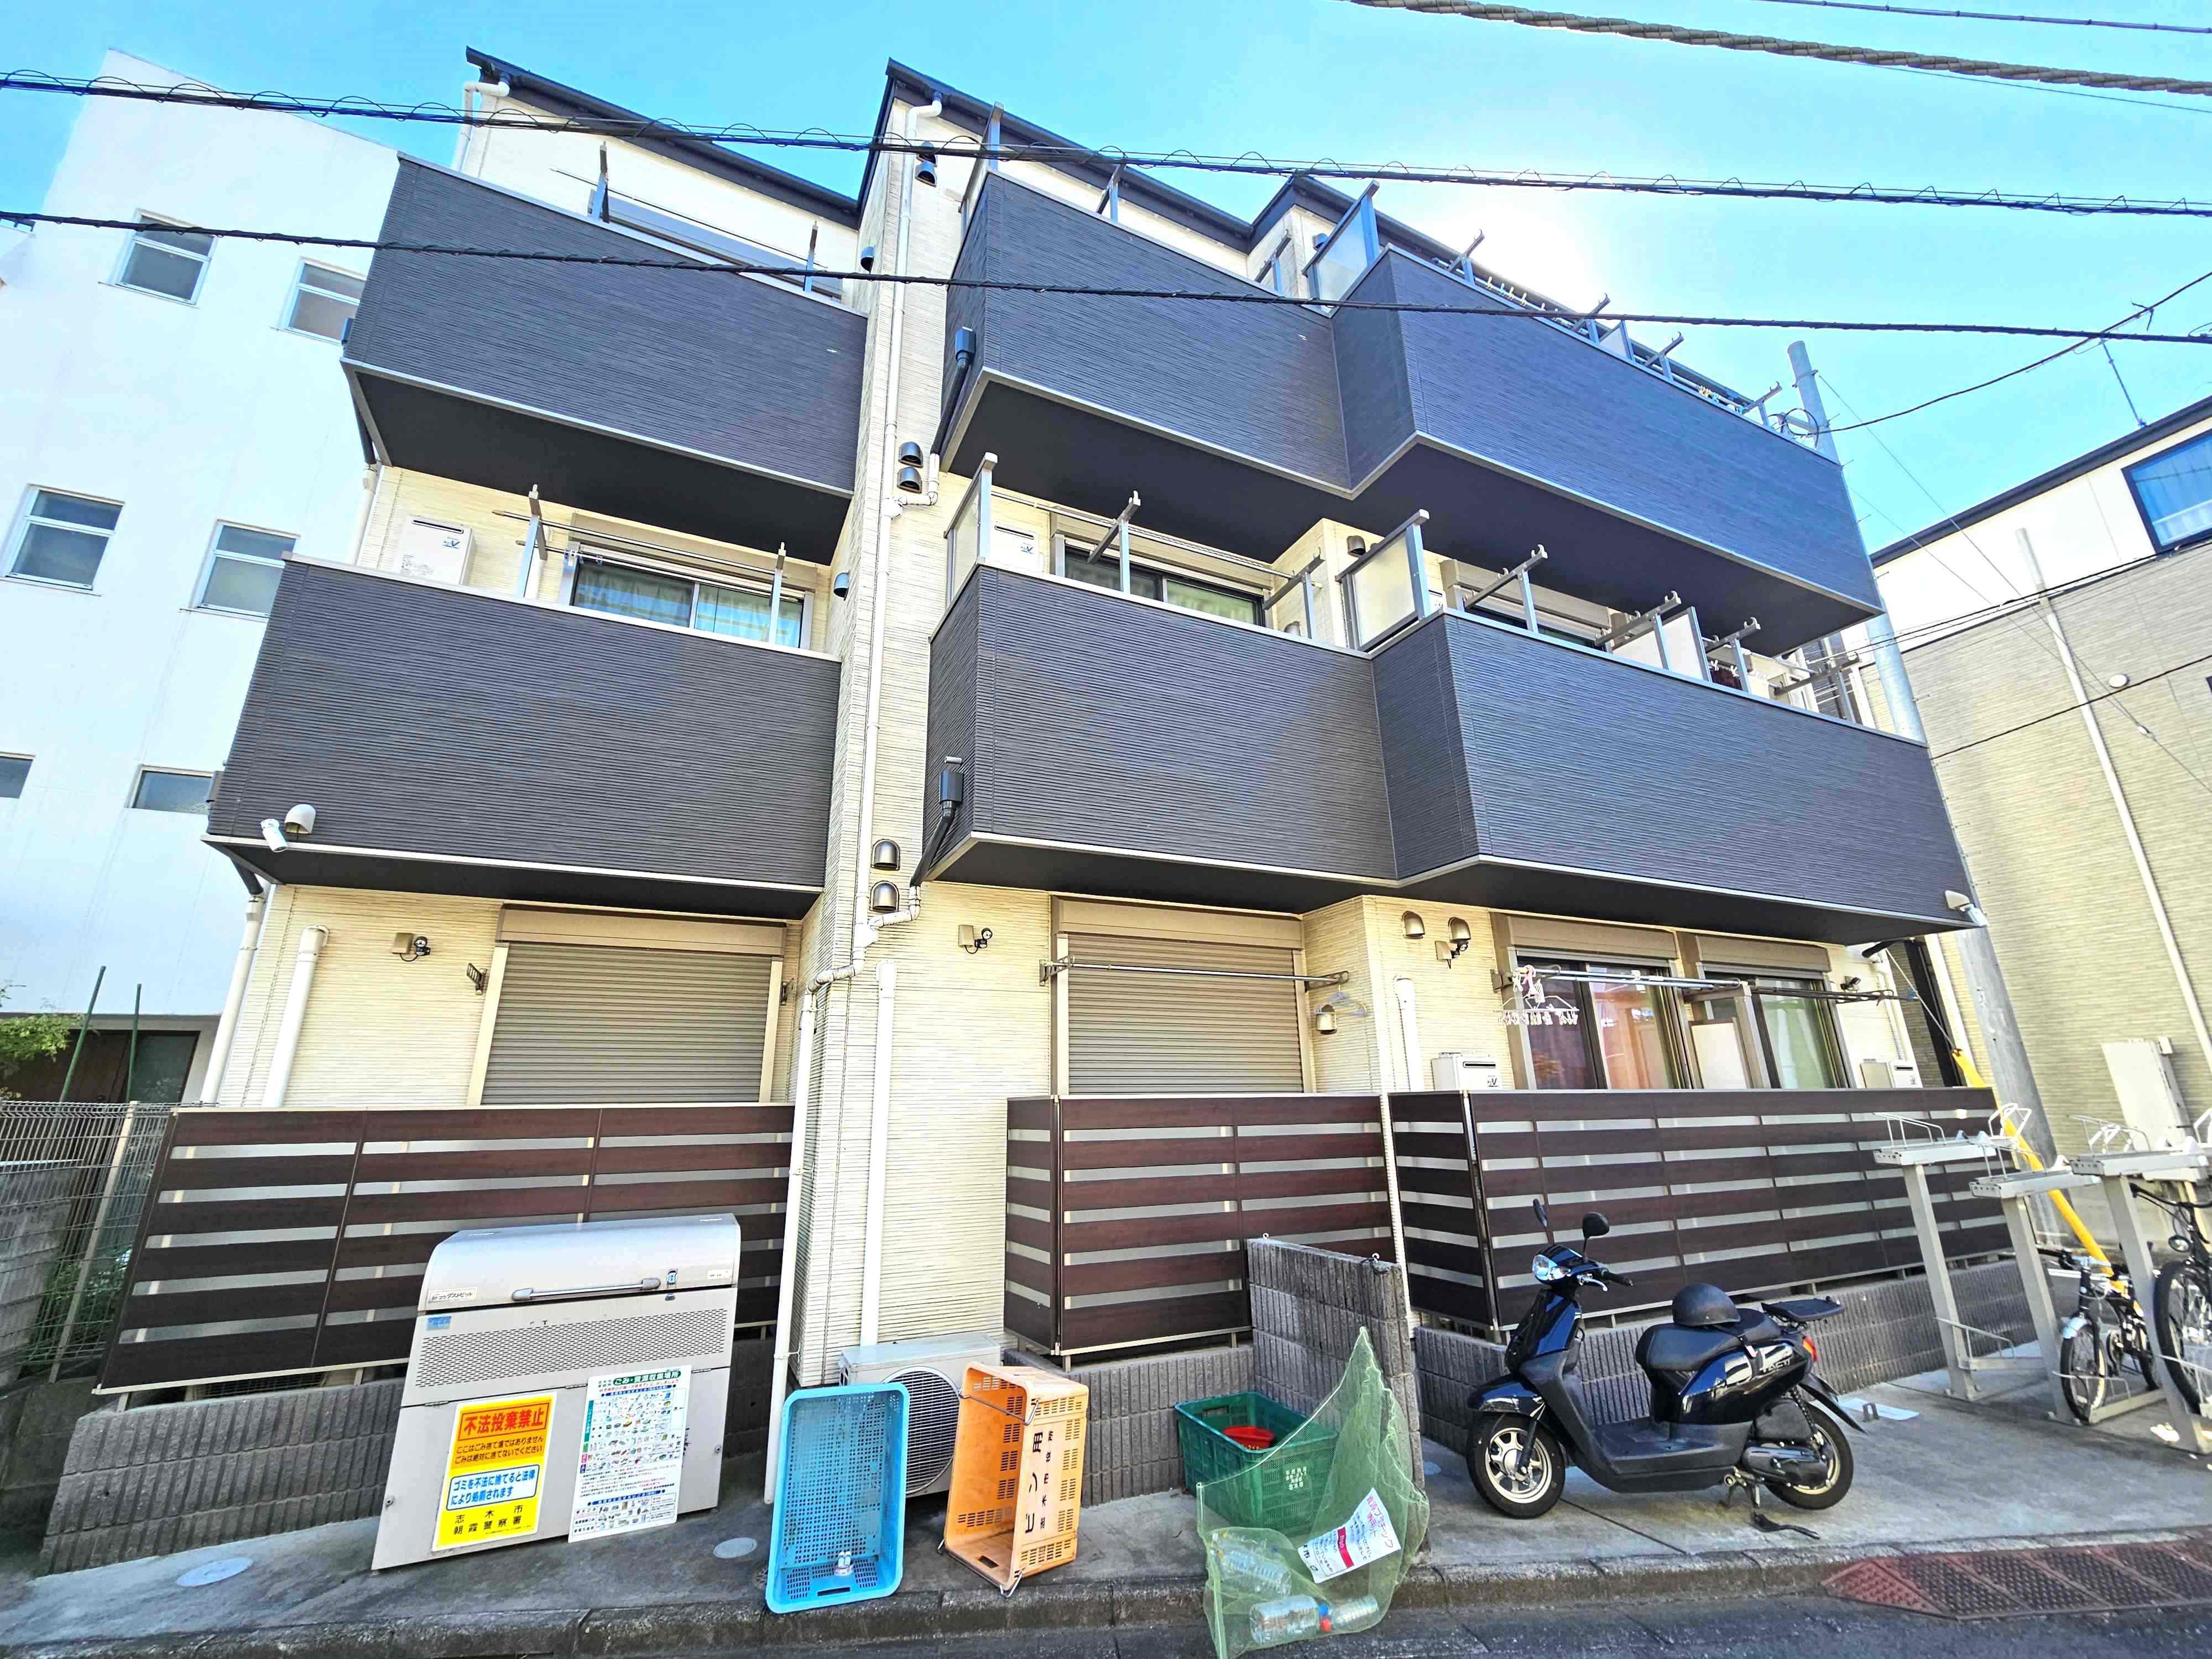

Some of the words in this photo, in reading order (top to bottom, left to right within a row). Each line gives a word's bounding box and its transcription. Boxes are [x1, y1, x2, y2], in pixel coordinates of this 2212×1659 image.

[464, 1407, 544, 1436] 不法投棄禁止
[455, 1446, 542, 1464] ごみは絶対に捨てないでください
[456, 1436, 544, 1454] ここはごみ捨て場ではありません
[453, 1469, 535, 1491] ゴミを不法に捨てると法律
